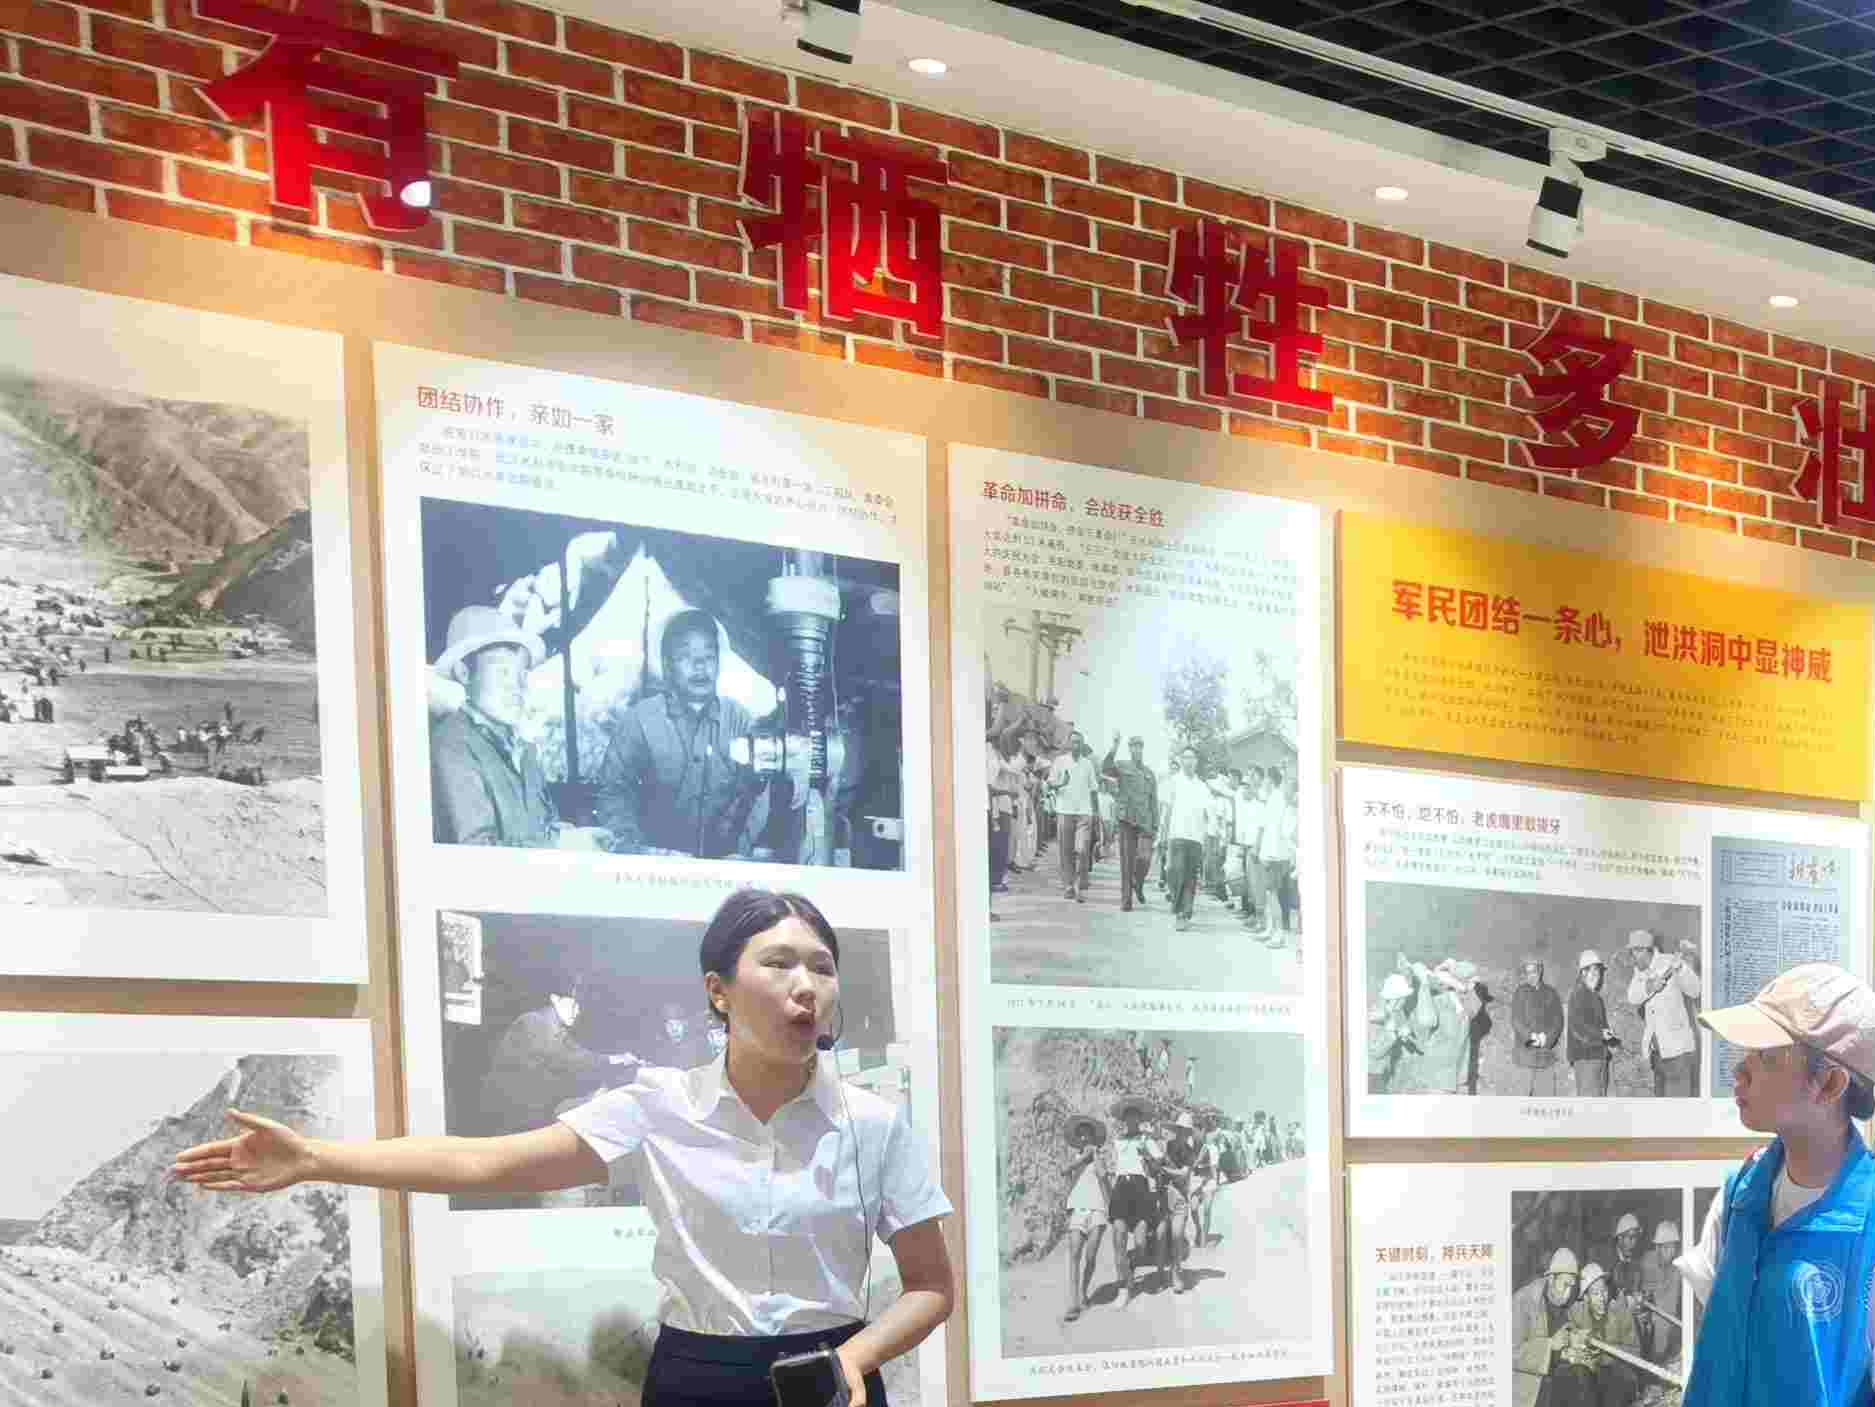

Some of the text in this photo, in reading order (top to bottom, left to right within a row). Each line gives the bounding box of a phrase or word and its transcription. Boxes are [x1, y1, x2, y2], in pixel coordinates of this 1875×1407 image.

[1393, 580, 1832, 683] 军民团结一条心，泄洪洞中显神威
